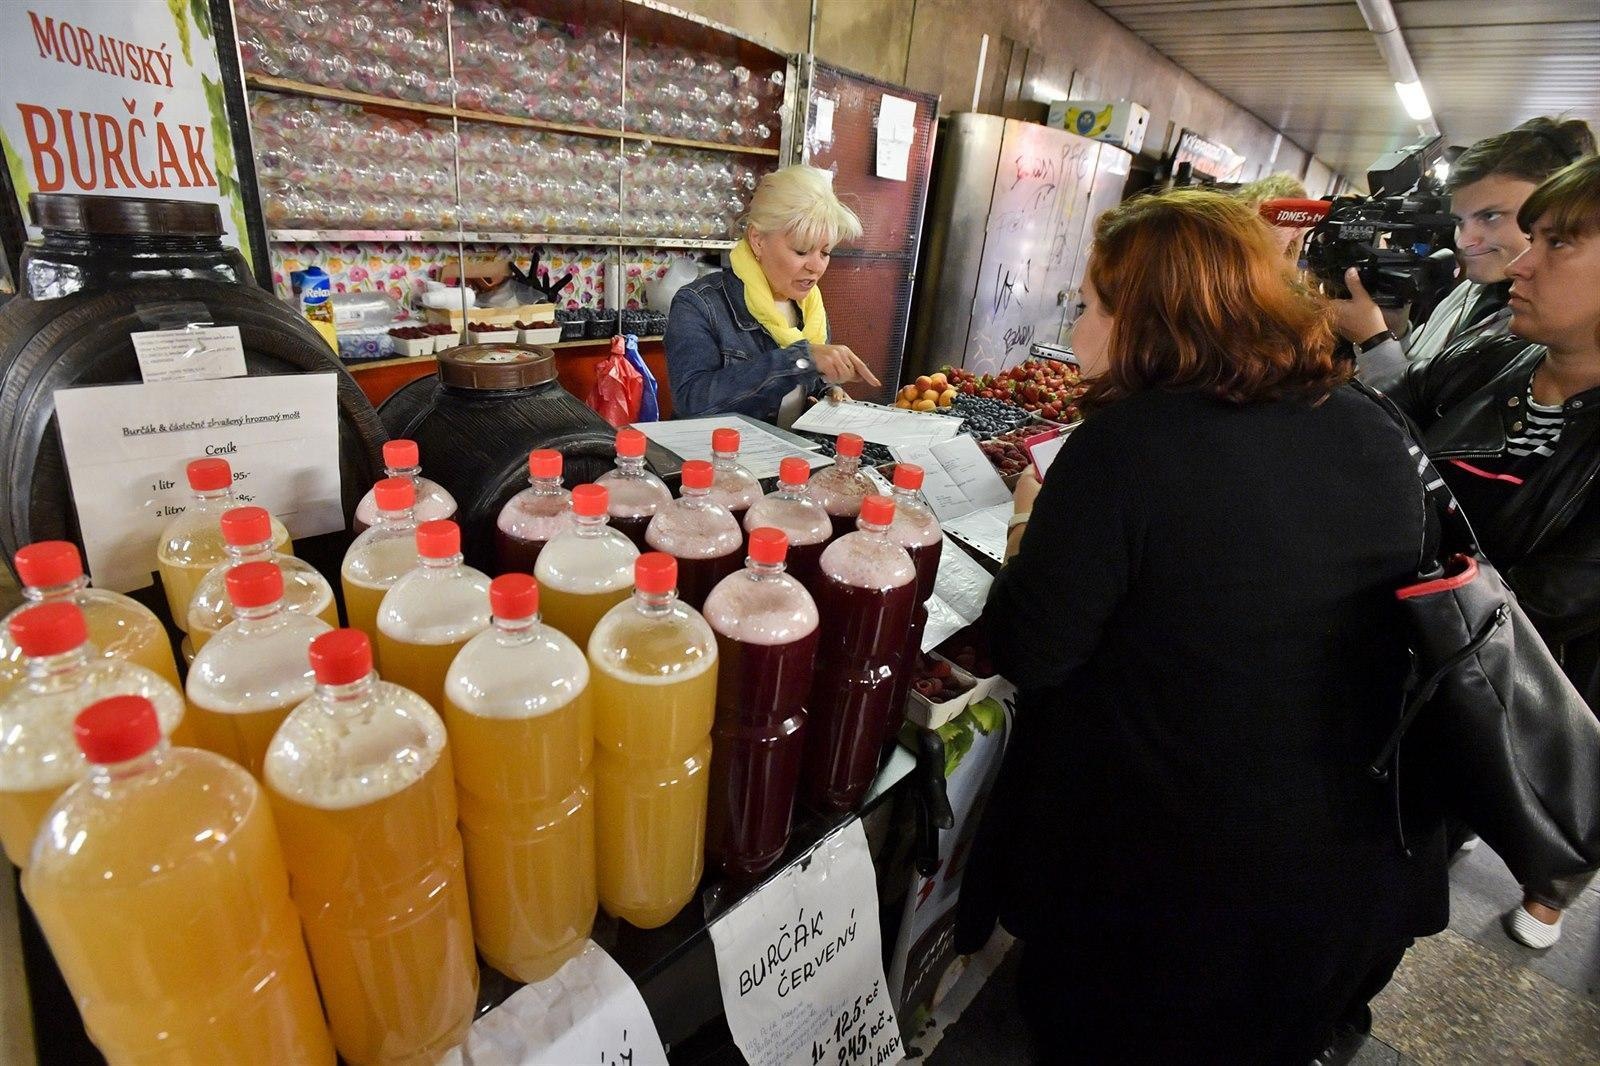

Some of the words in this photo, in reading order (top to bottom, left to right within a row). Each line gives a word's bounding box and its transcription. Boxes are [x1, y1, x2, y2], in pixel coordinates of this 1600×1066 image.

[27, 10, 175, 88] MORAVSKÝ
[16, 97, 217, 193] BURČÁK
[1276, 210, 1309, 222] iDNES
[122, 424, 157, 437] Burčák
[158, 423, 168, 433] &
[245, 412, 281, 424] hroznový
[282, 410, 301, 420] mošt
[205, 441, 238, 455] Ceník
[151, 482, 157, 491] 1
[159, 479, 176, 491] litr
[156, 509, 162, 518] 2
[739, 907, 824, 998] BURČÁK
[777, 907, 857, 998] ČERVENÝ
